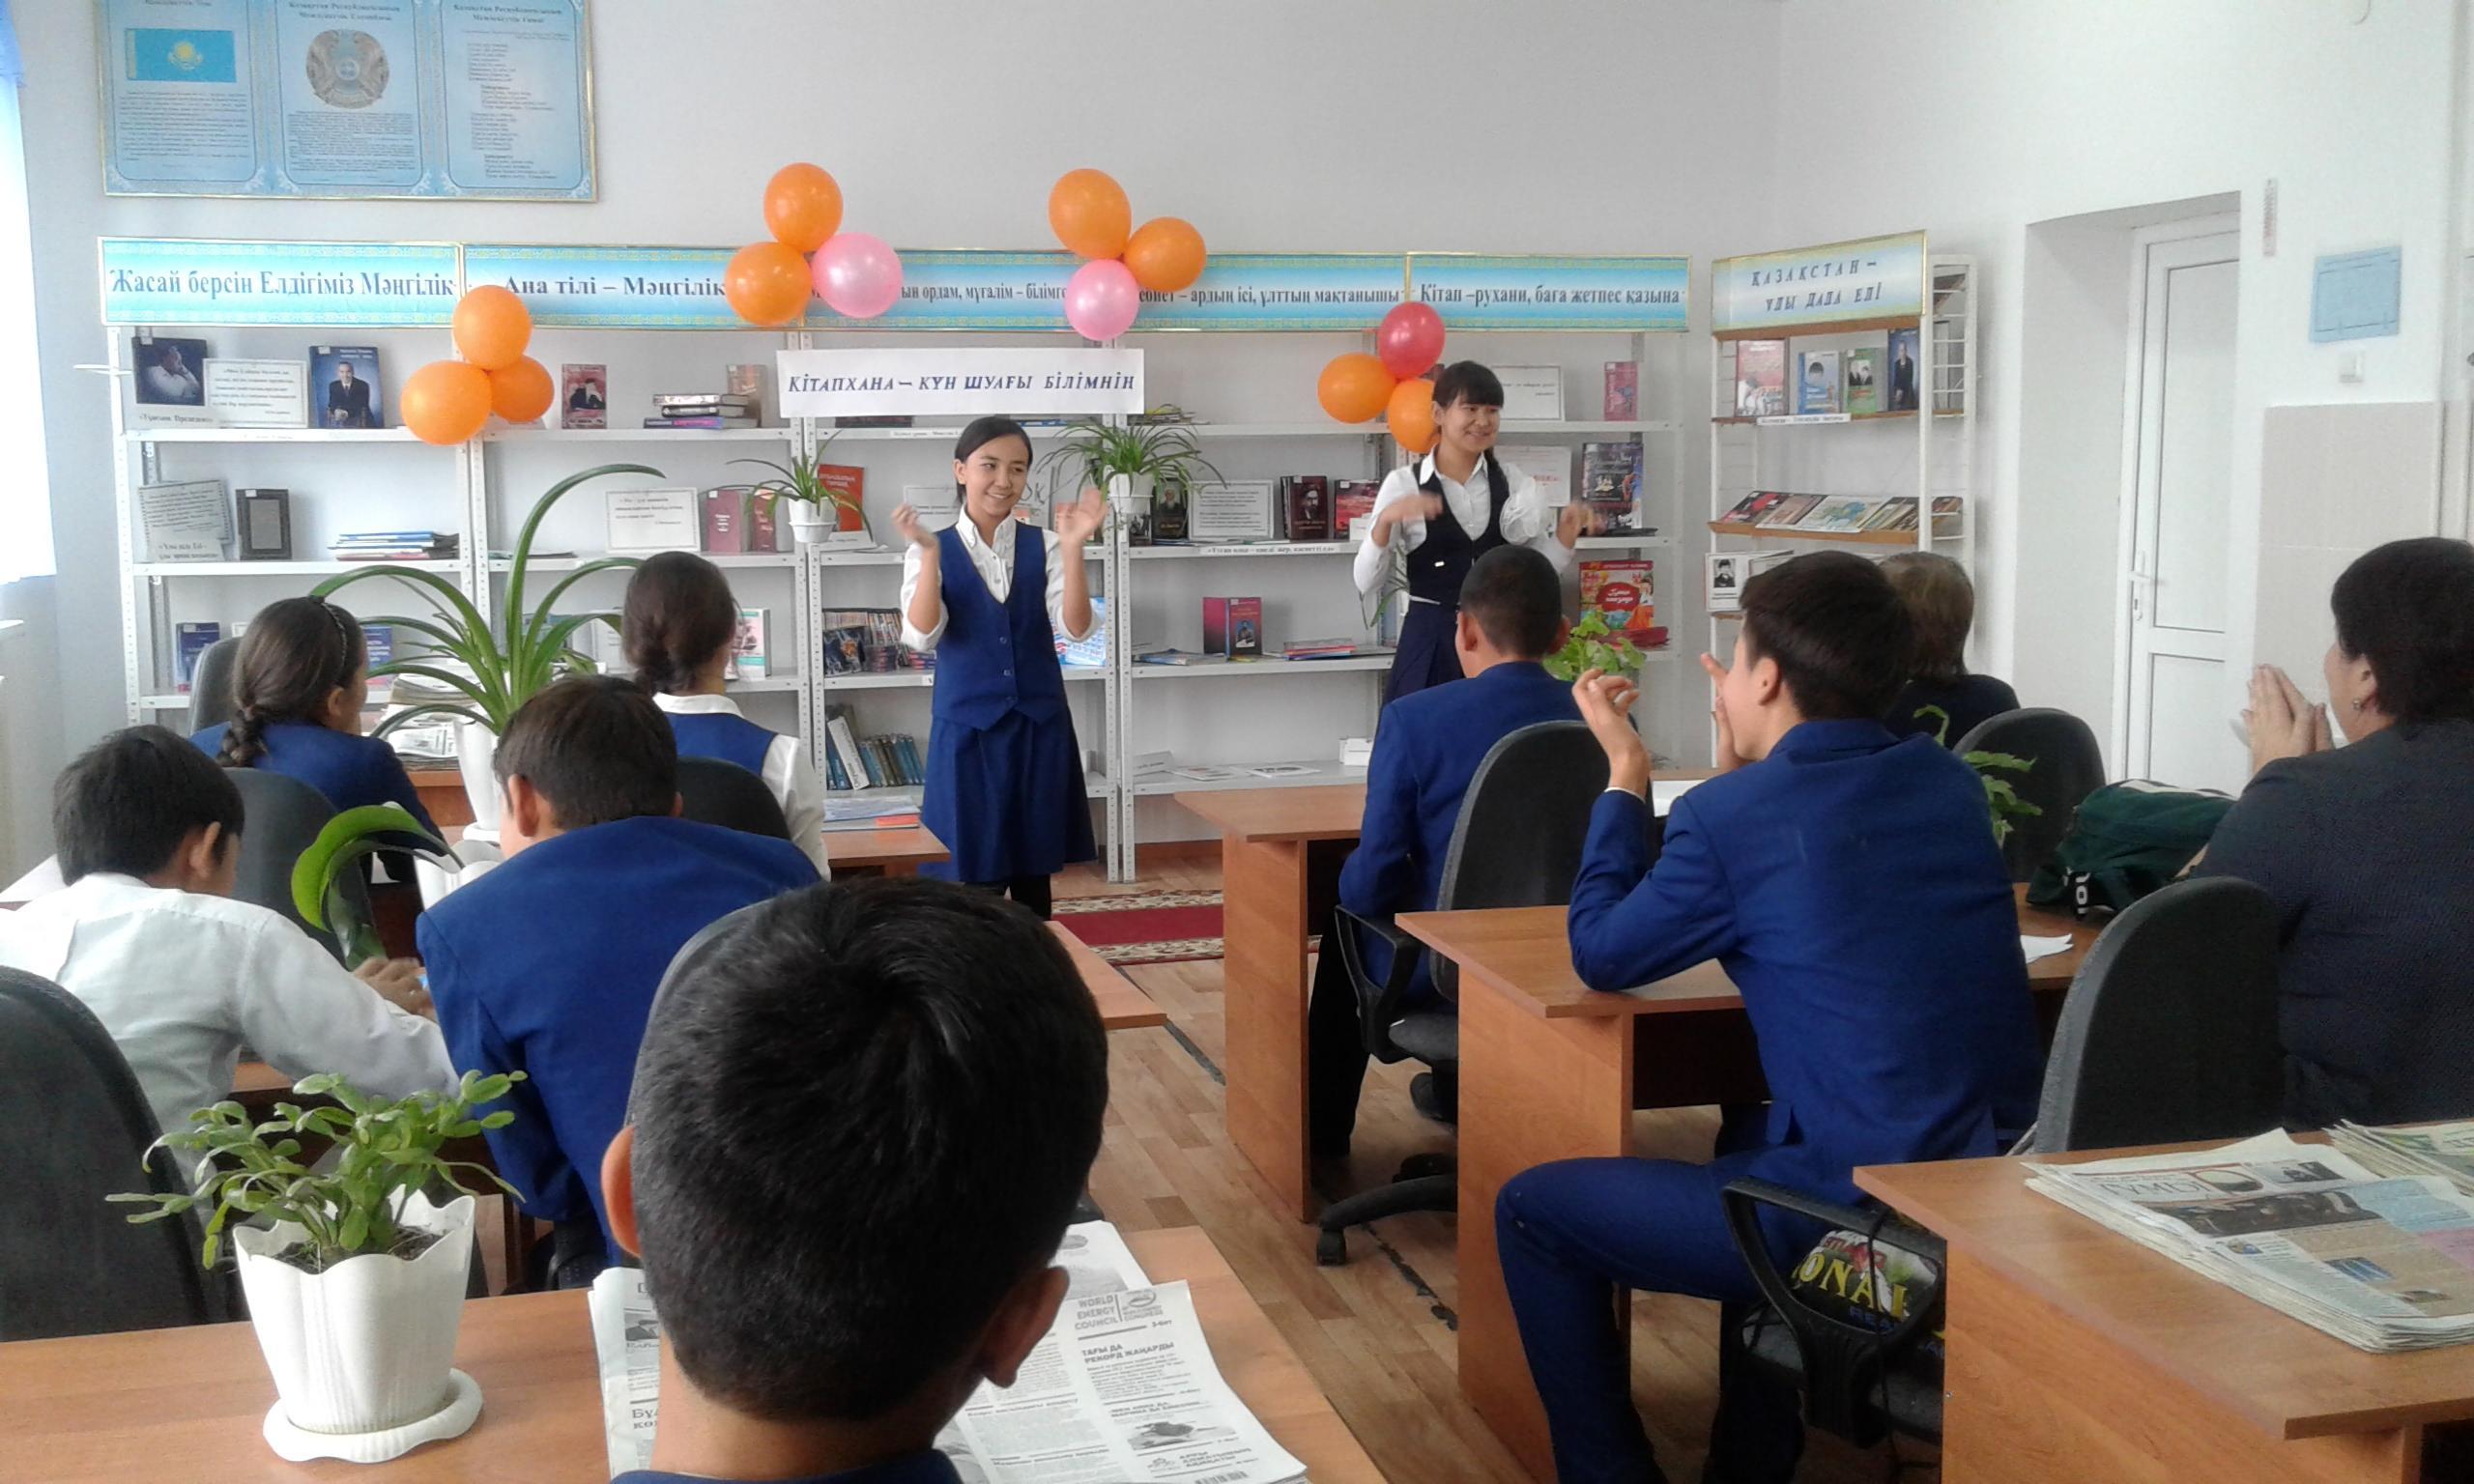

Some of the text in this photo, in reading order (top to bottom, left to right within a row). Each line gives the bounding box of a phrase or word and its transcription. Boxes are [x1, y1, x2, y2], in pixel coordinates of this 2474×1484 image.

[109, 269, 454, 300] Жасай берсін Елдігіміз Мәңгілік
[505, 276, 548, 294] Ана
[556, 276, 596, 295] тілі
[1420, 283, 1462, 302] Кітап
[1569, 289, 1621, 303] жетпес
[1804, 291, 1842, 311] ДАЛА
[788, 373, 894, 392] КІТАПХАНА
[964, 376, 1033, 389] ШУАҒЫ
[1078, 1295, 1114, 1307] WORLD
[1077, 1306, 1116, 1320] ENERGY
[1075, 1317, 1119, 1330] COUNCIL
[1084, 1353, 1124, 1364] РЕКОРД
